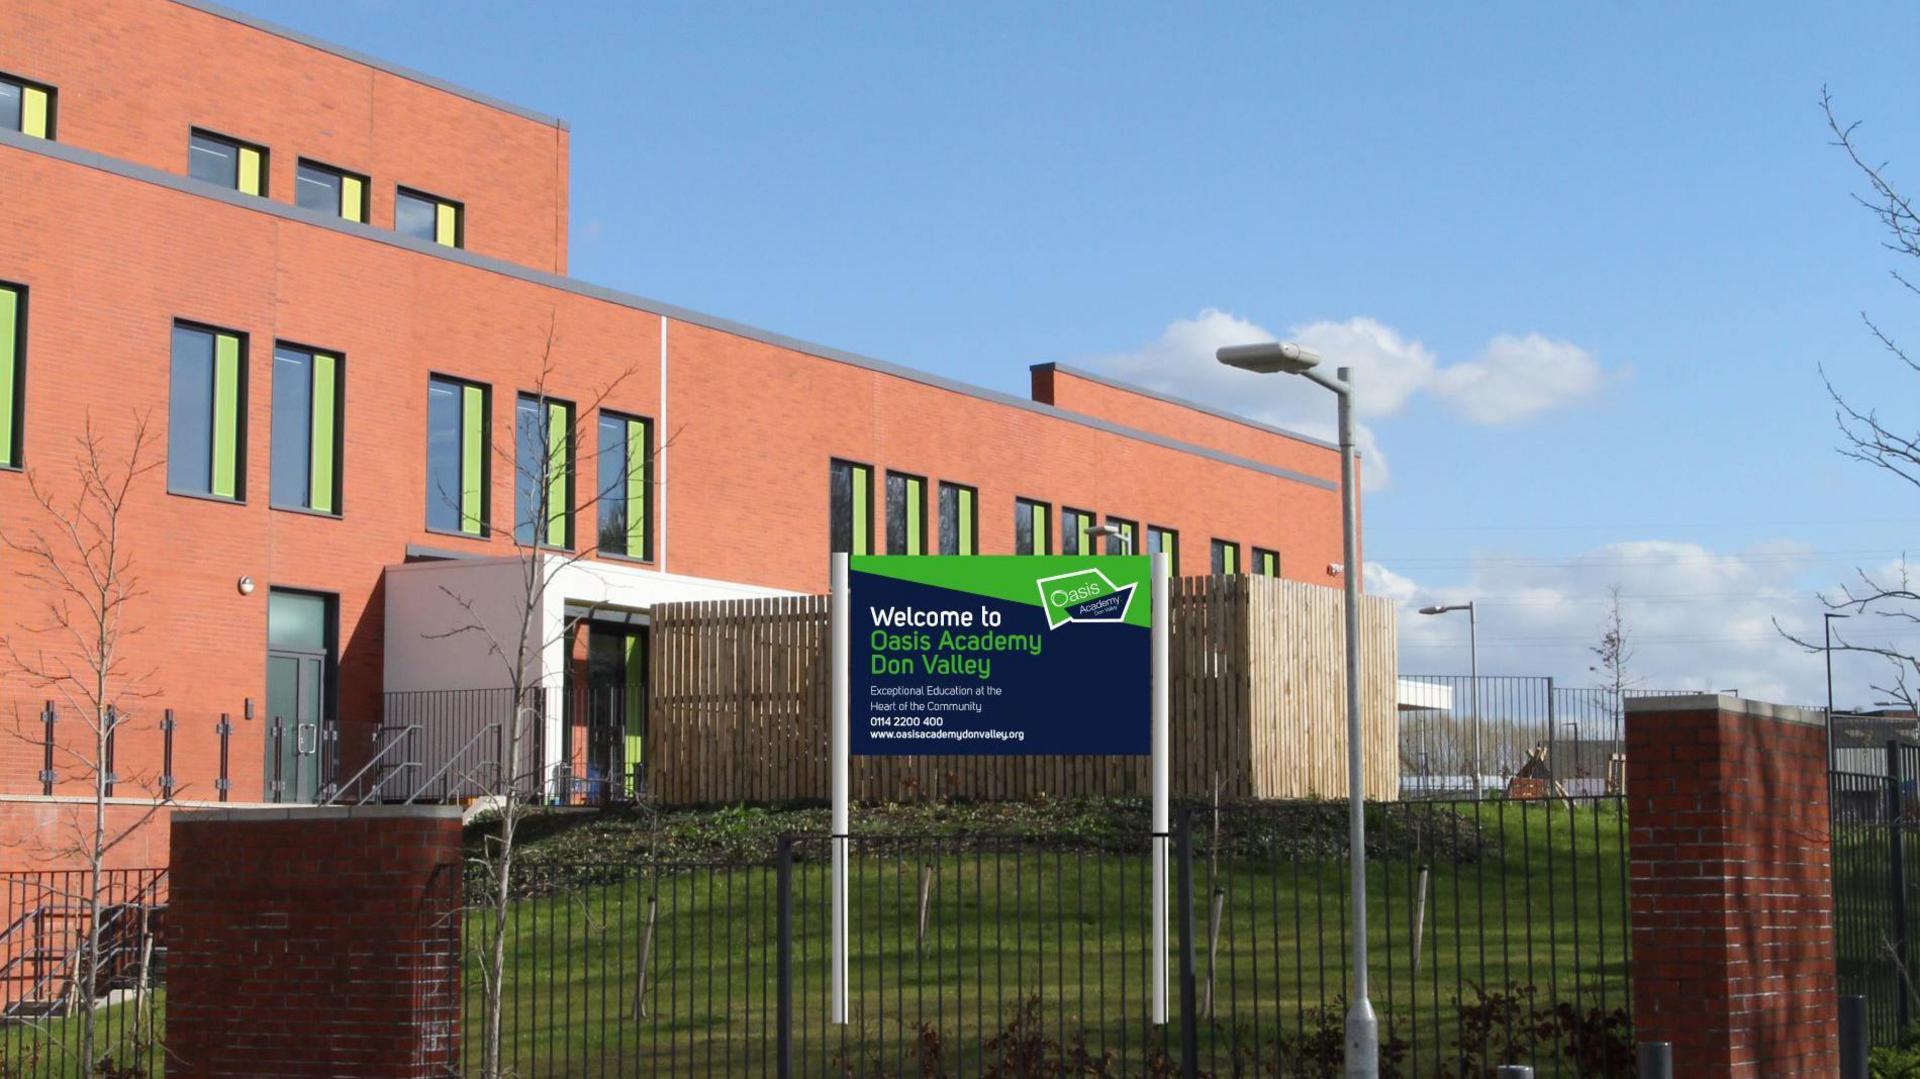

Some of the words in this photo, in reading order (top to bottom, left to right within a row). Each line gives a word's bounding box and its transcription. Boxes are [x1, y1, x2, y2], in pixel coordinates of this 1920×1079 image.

[1050, 582, 1100, 607] Oasis
[1079, 596, 1120, 614] Academy
[870, 606, 973, 627] Welcome
[981, 605, 1001, 627] to
[871, 630, 931, 651] Oasis
[938, 630, 1042, 655] Academy
[871, 654, 914, 674] Don
[921, 654, 991, 679] Valley
[870, 686, 924, 697] Exceptional
[927, 686, 973, 696] Education
[975, 686, 985, 696] at
[986, 686, 1002, 696] the
[870, 702, 896, 711] Heart
[899, 702, 910, 711] of
[910, 702, 925, 711] the
[927, 702, 982, 713] Community
[870, 717, 891, 726] 0114
[893, 717, 920, 726] 2200
[923, 717, 944, 726] 400
[870, 729, 1025, 741] www.oasisacademydonvalley.org
